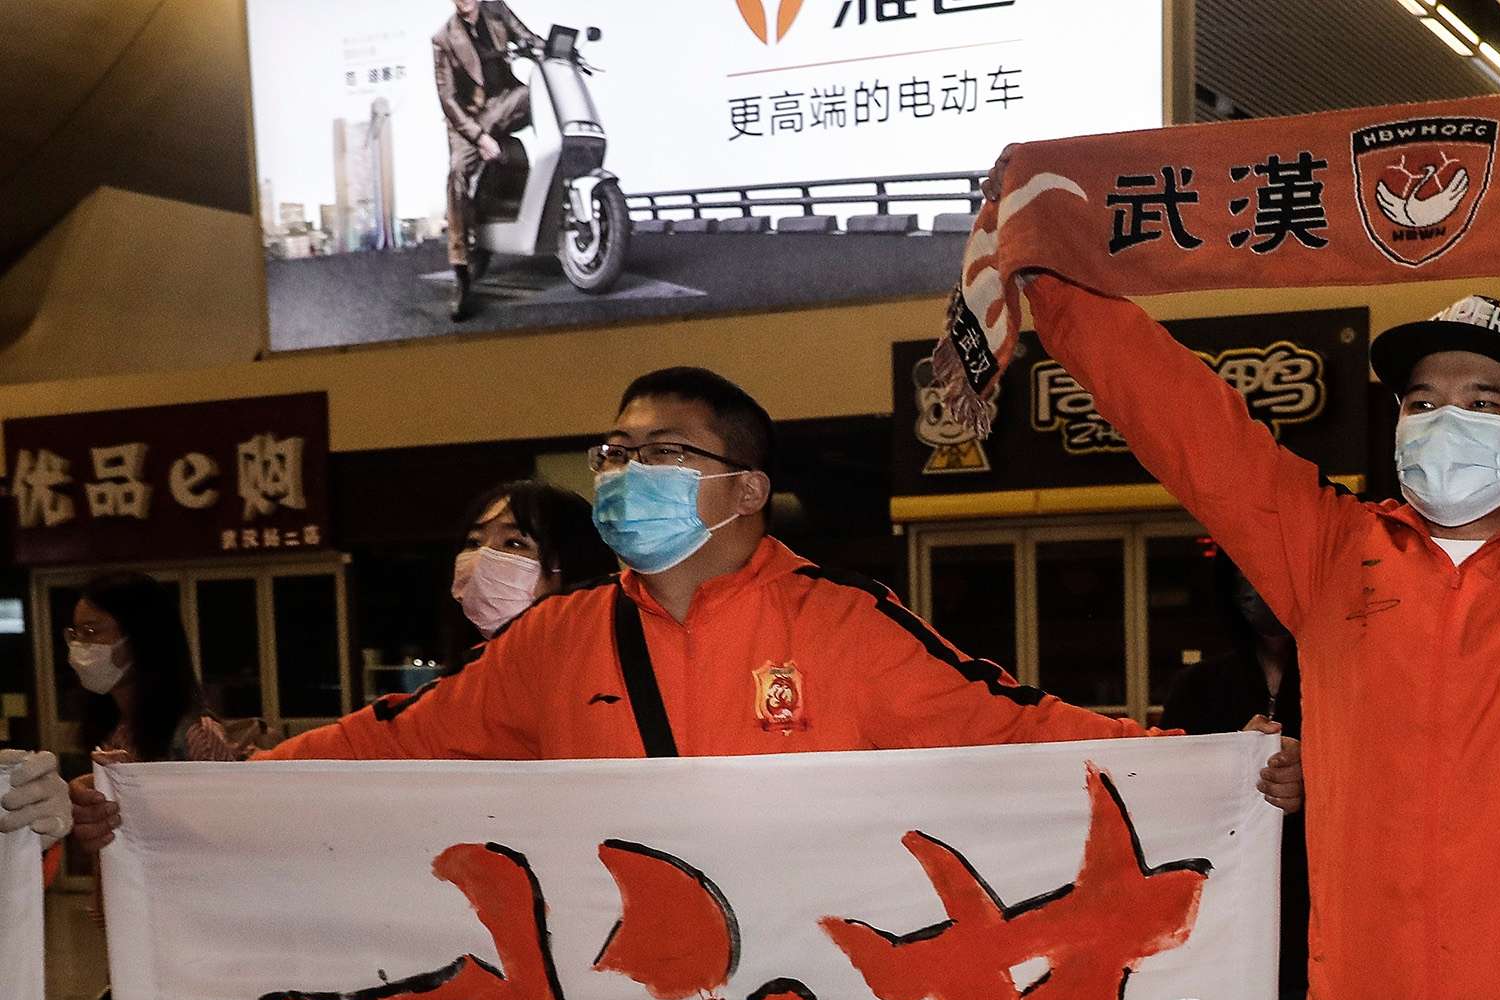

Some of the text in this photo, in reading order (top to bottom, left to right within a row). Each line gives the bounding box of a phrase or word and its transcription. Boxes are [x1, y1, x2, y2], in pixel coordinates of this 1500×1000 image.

[728, 65, 1023, 141] 更高端的电动车
[1105, 150, 1329, 256] 武漢
